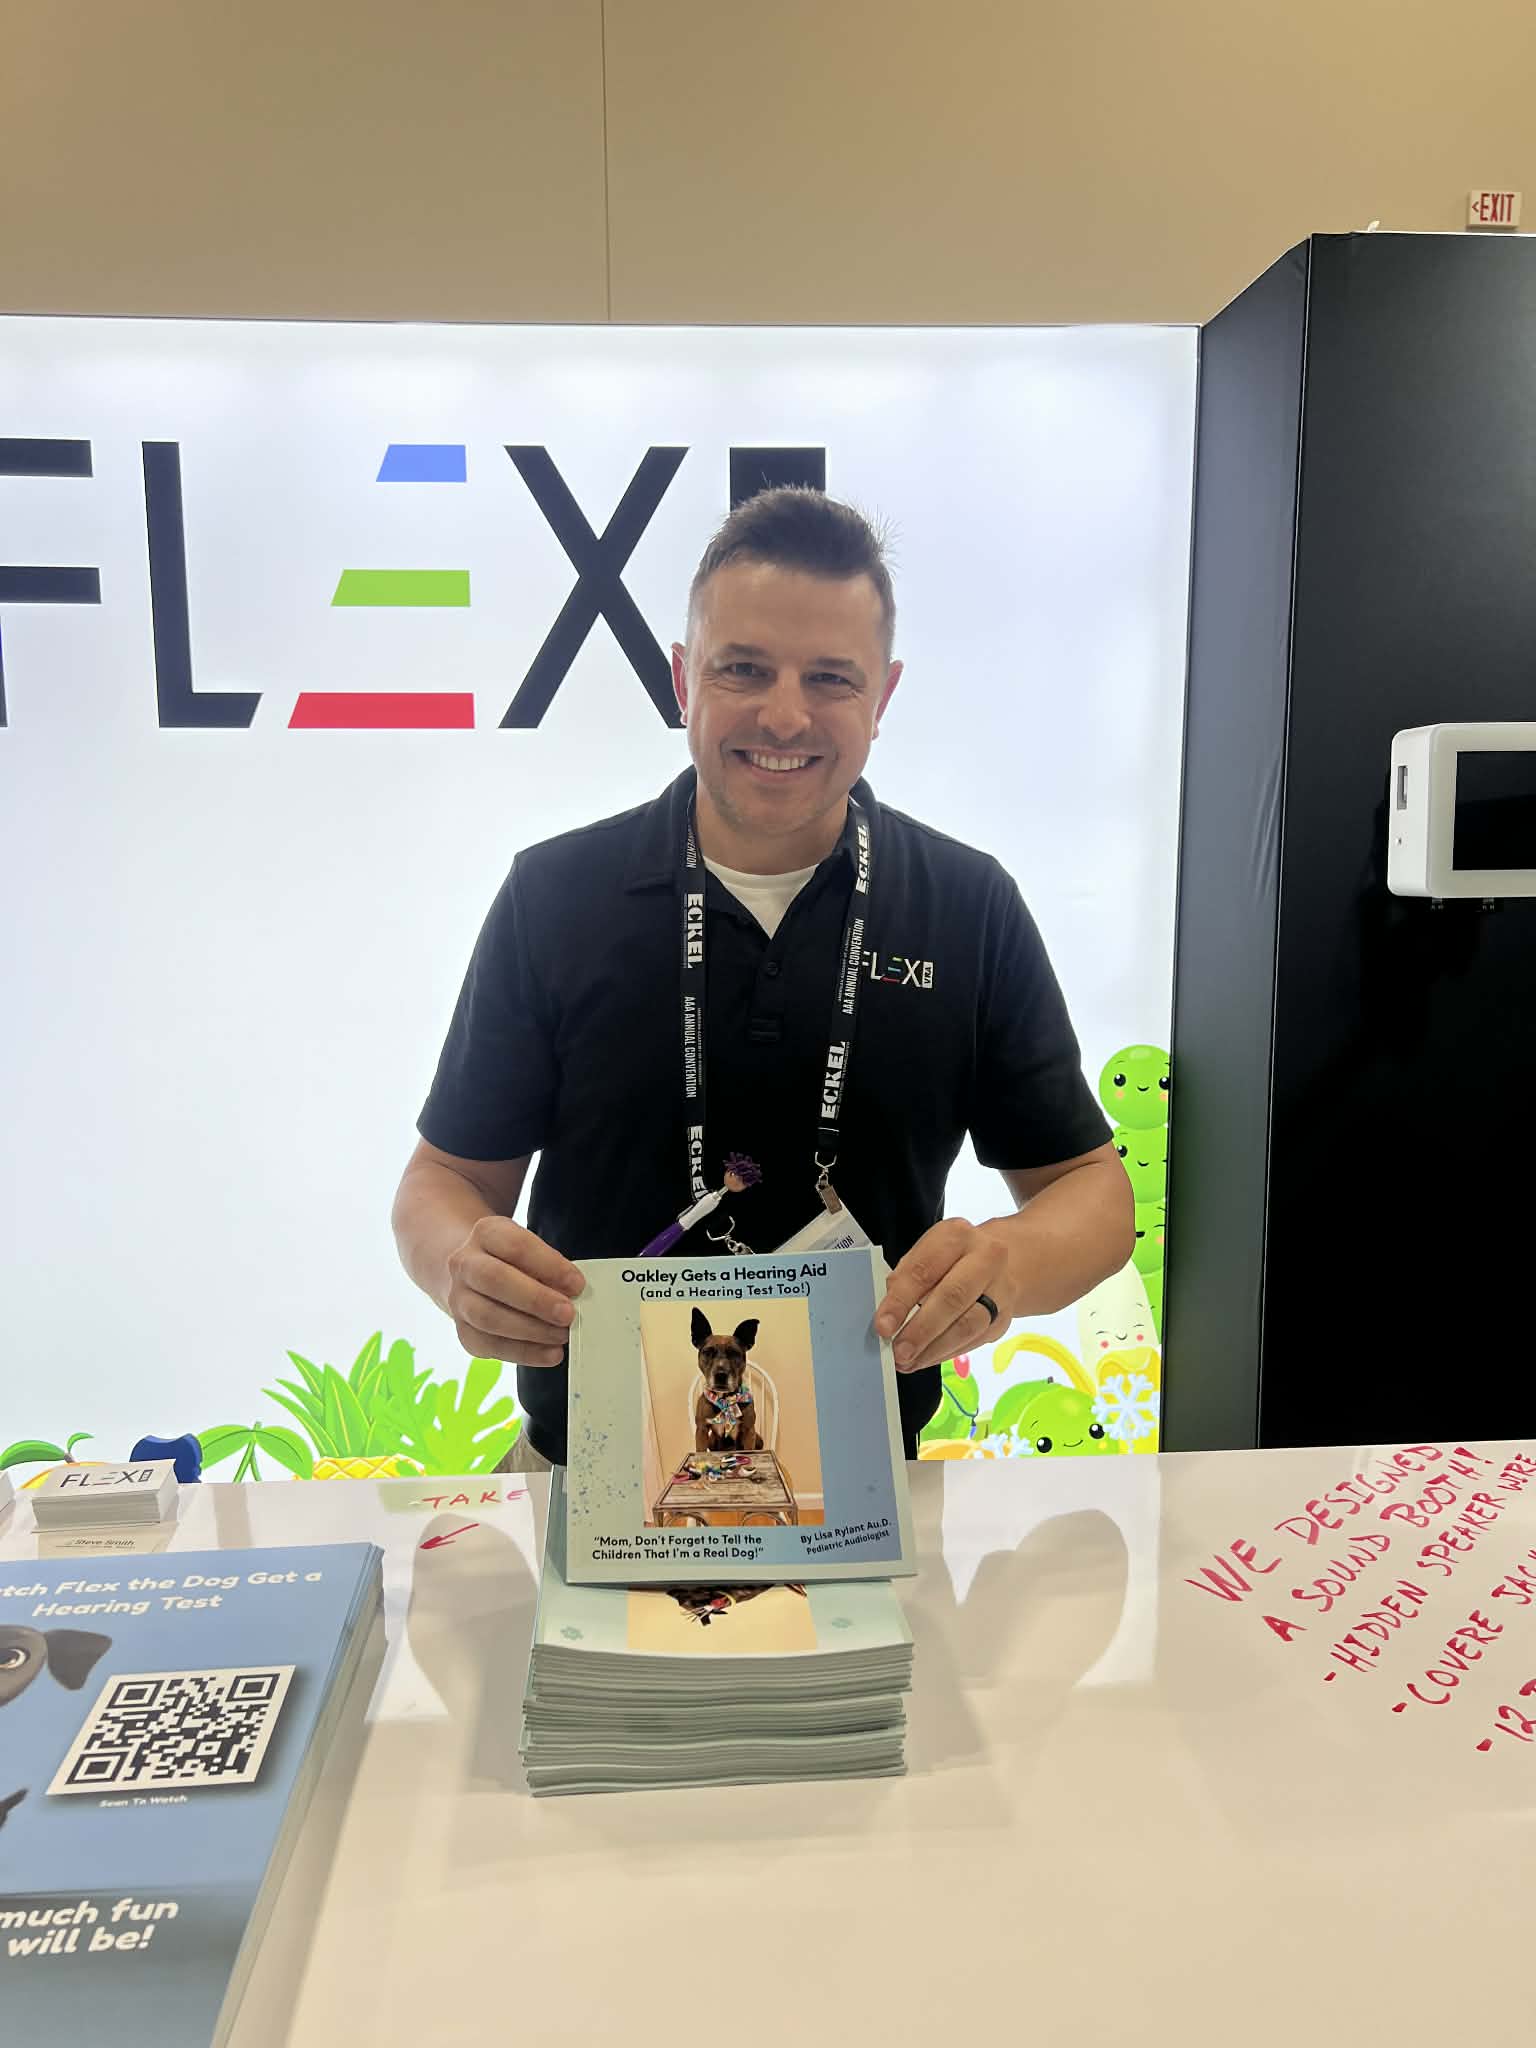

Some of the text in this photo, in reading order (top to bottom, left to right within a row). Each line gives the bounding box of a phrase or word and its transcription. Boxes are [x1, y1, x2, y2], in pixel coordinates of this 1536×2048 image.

[1480, 193, 1515, 222] EXIT
[856, 825, 868, 894] ECKEL
[687, 893, 704, 968] ECKEL
[849, 918, 865, 966] CONVENTION
[845, 967, 858, 998] ANNUAL
[842, 1000, 855, 1015] AAA
[684, 996, 696, 1098] AAA ANNUAL CONVENTION
[821, 1041, 846, 1119] ECKEL
[621, 1263, 827, 1285] Oakley Gets a Hearing Aid
[640, 1282, 811, 1301] (and a Hearing Test Too!)
[422, 1488, 529, 1509] TAKE
[800, 1535, 812, 1544] By
[814, 1531, 833, 1540] Lisa
[834, 1524, 864, 1537] Rylant
[1184, 1445, 1443, 1602] WE DESIGNED
[592, 1549, 641, 1560] Children
[644, 1548, 670, 1559] That
[673, 1548, 690, 1558] I'm
[693, 1550, 700, 1558] a
[703, 1547, 728, 1558] Real
[635, 1535, 665, 1546] Don't
[668, 1535, 705, 1548] Forget
[708, 1535, 719, 1545] to
[721, 1534, 741, 1545] Tell
[744, 1534, 762, 1545] the
[806, 1530, 890, 1555] Pediatric Audiologist
[1262, 1446, 1494, 1641] A SOUND BOOTH!
[0, 1571, 322, 1597] tch Flex the Dog Get a
[1330, 1580, 1429, 1673] HIDDEN
[1416, 1492, 1507, 1577] SPEAKER
[32, 1595, 223, 1617] Hearing Test
[0, 1897, 179, 1929] much fun
[7, 1924, 155, 1957] will be!
